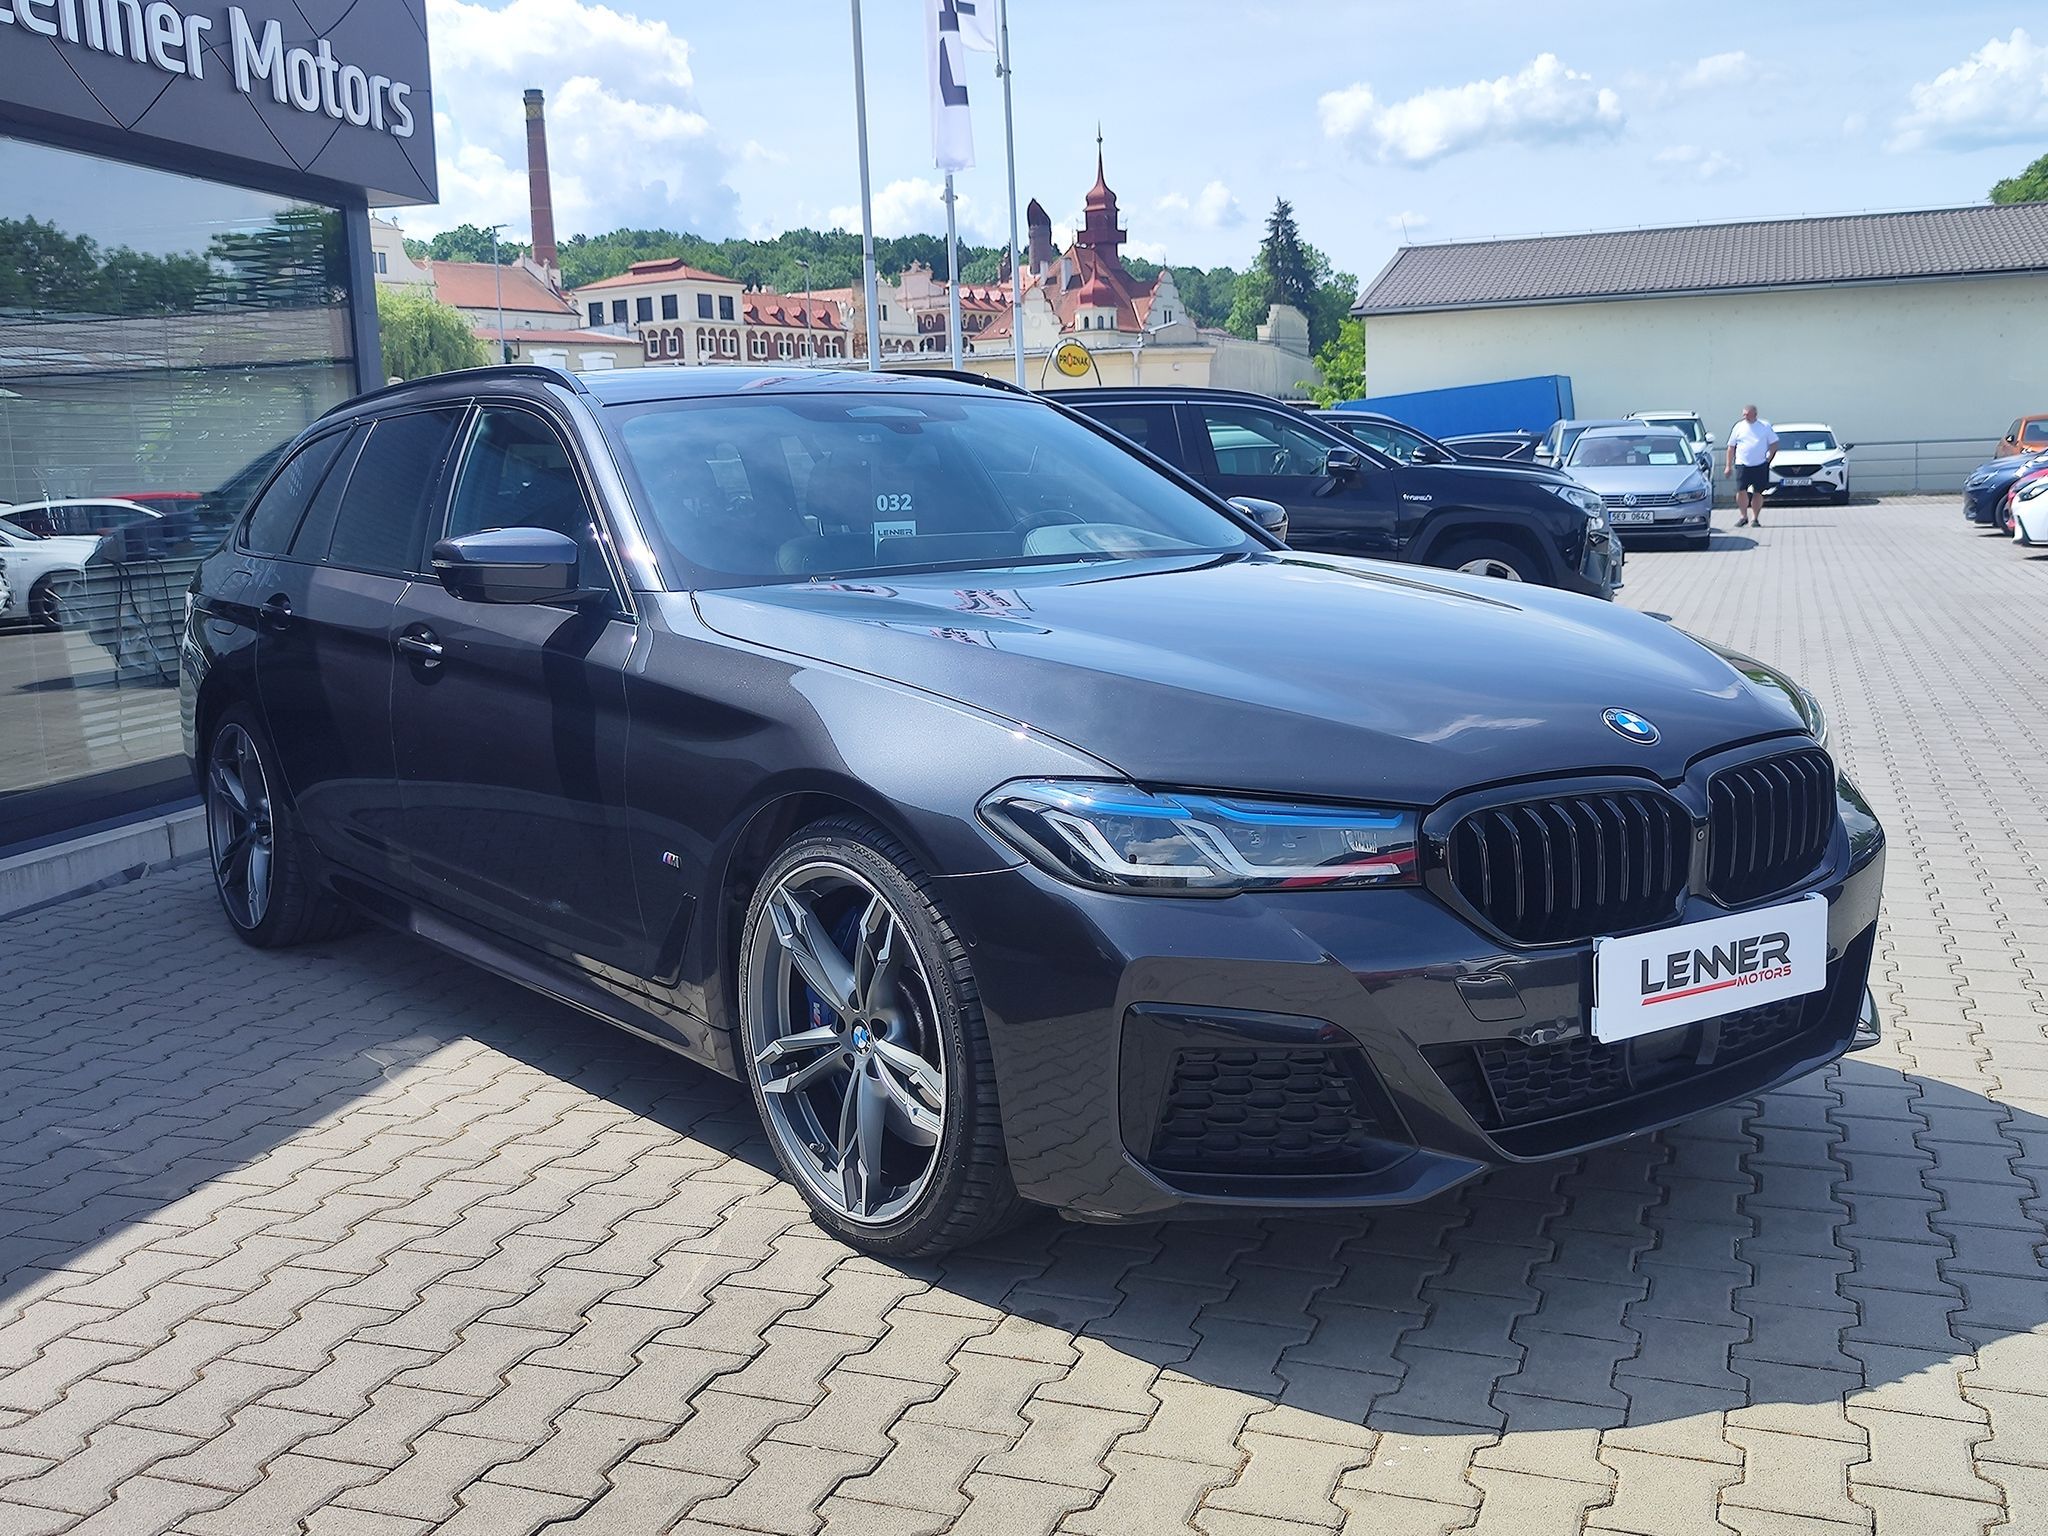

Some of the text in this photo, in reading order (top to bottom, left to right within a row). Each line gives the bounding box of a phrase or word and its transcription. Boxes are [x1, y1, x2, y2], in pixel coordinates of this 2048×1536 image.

[228, 6, 415, 138] Motors
[876, 493, 913, 512] 032
[877, 528, 913, 536] LENNER
[1641, 931, 1791, 995] LENNER
[1736, 964, 1792, 987] MOTORS
